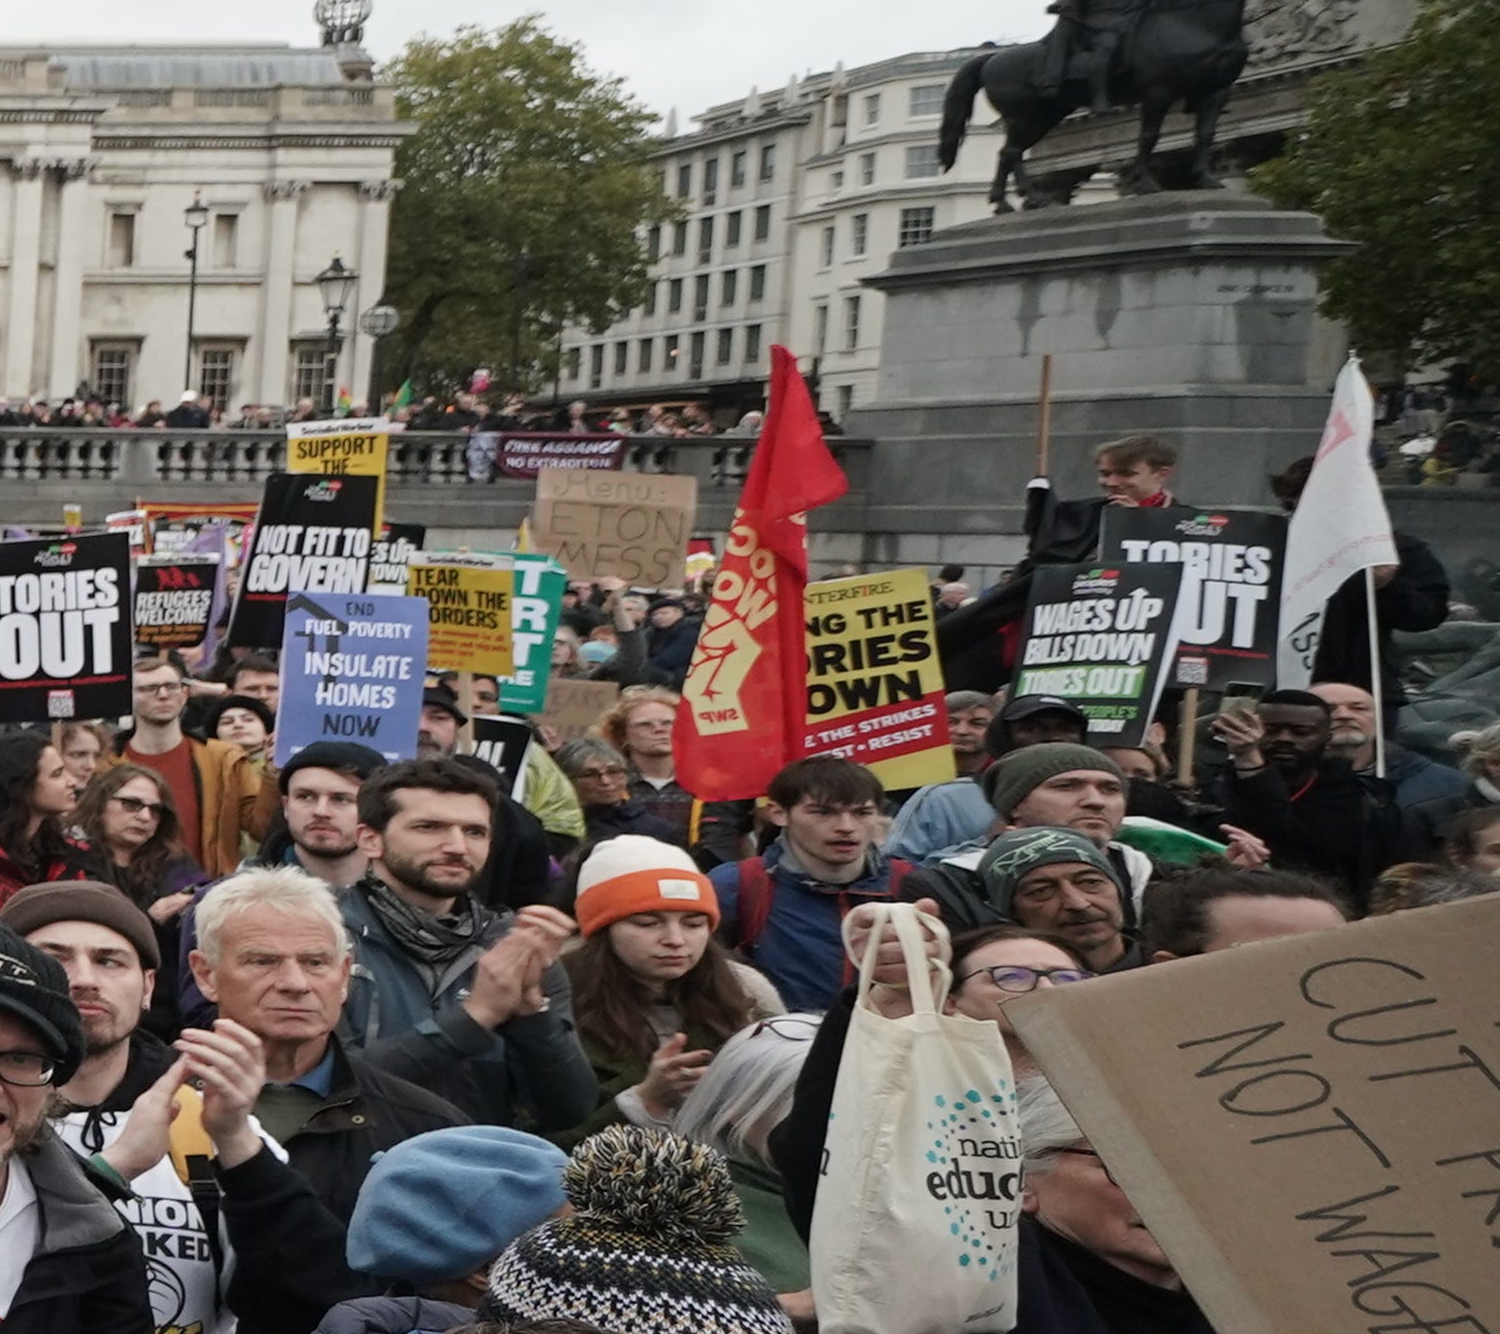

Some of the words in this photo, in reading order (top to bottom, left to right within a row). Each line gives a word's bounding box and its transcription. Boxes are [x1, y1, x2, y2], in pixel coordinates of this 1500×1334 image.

[296, 436, 377, 460] SUPPORT
[504, 440, 541, 453] FREE
[542, 440, 622, 454] ASSANGE
[321, 459, 349, 475] THE
[506, 457, 525, 468] NO
[527, 457, 612, 468] EXTRADITION
[551, 502, 683, 545] ETON
[255, 525, 304, 554] NOT
[302, 527, 343, 556] FIT
[342, 527, 371, 557] TO
[246, 553, 368, 594] GOVERN
[555, 541, 679, 584] MESS
[415, 569, 459, 586] TEAR
[136, 590, 212, 610] REFUGEES
[346, 603, 374, 616] END
[476, 591, 509, 611] THE
[856, 600, 928, 629] THE
[1032, 598, 1113, 636] WAGES
[1115, 588, 1164, 631] UP
[135, 608, 209, 626] WELCOME
[305, 619, 341, 636] FUEL
[348, 621, 413, 639] POVERTY
[429, 608, 498, 629] ORDERS
[806, 630, 931, 676] RIES
[1024, 636, 1075, 666] BILLS
[1075, 633, 1156, 665] DOWN
[304, 651, 413, 680] INSULATE
[807, 670, 924, 715] OWN
[1021, 668, 1087, 696] TORIES
[1086, 667, 1142, 695] OUT
[315, 683, 396, 710] HOMES
[322, 714, 381, 737] NOW
[818, 725, 856, 743] THE
[859, 704, 937, 734] STRIKES
[868, 724, 934, 750] RESIST
[1300, 957, 1500, 1092] CUT
[1178, 1021, 1392, 1169] NOT
[927, 1158, 1023, 1201] educ
